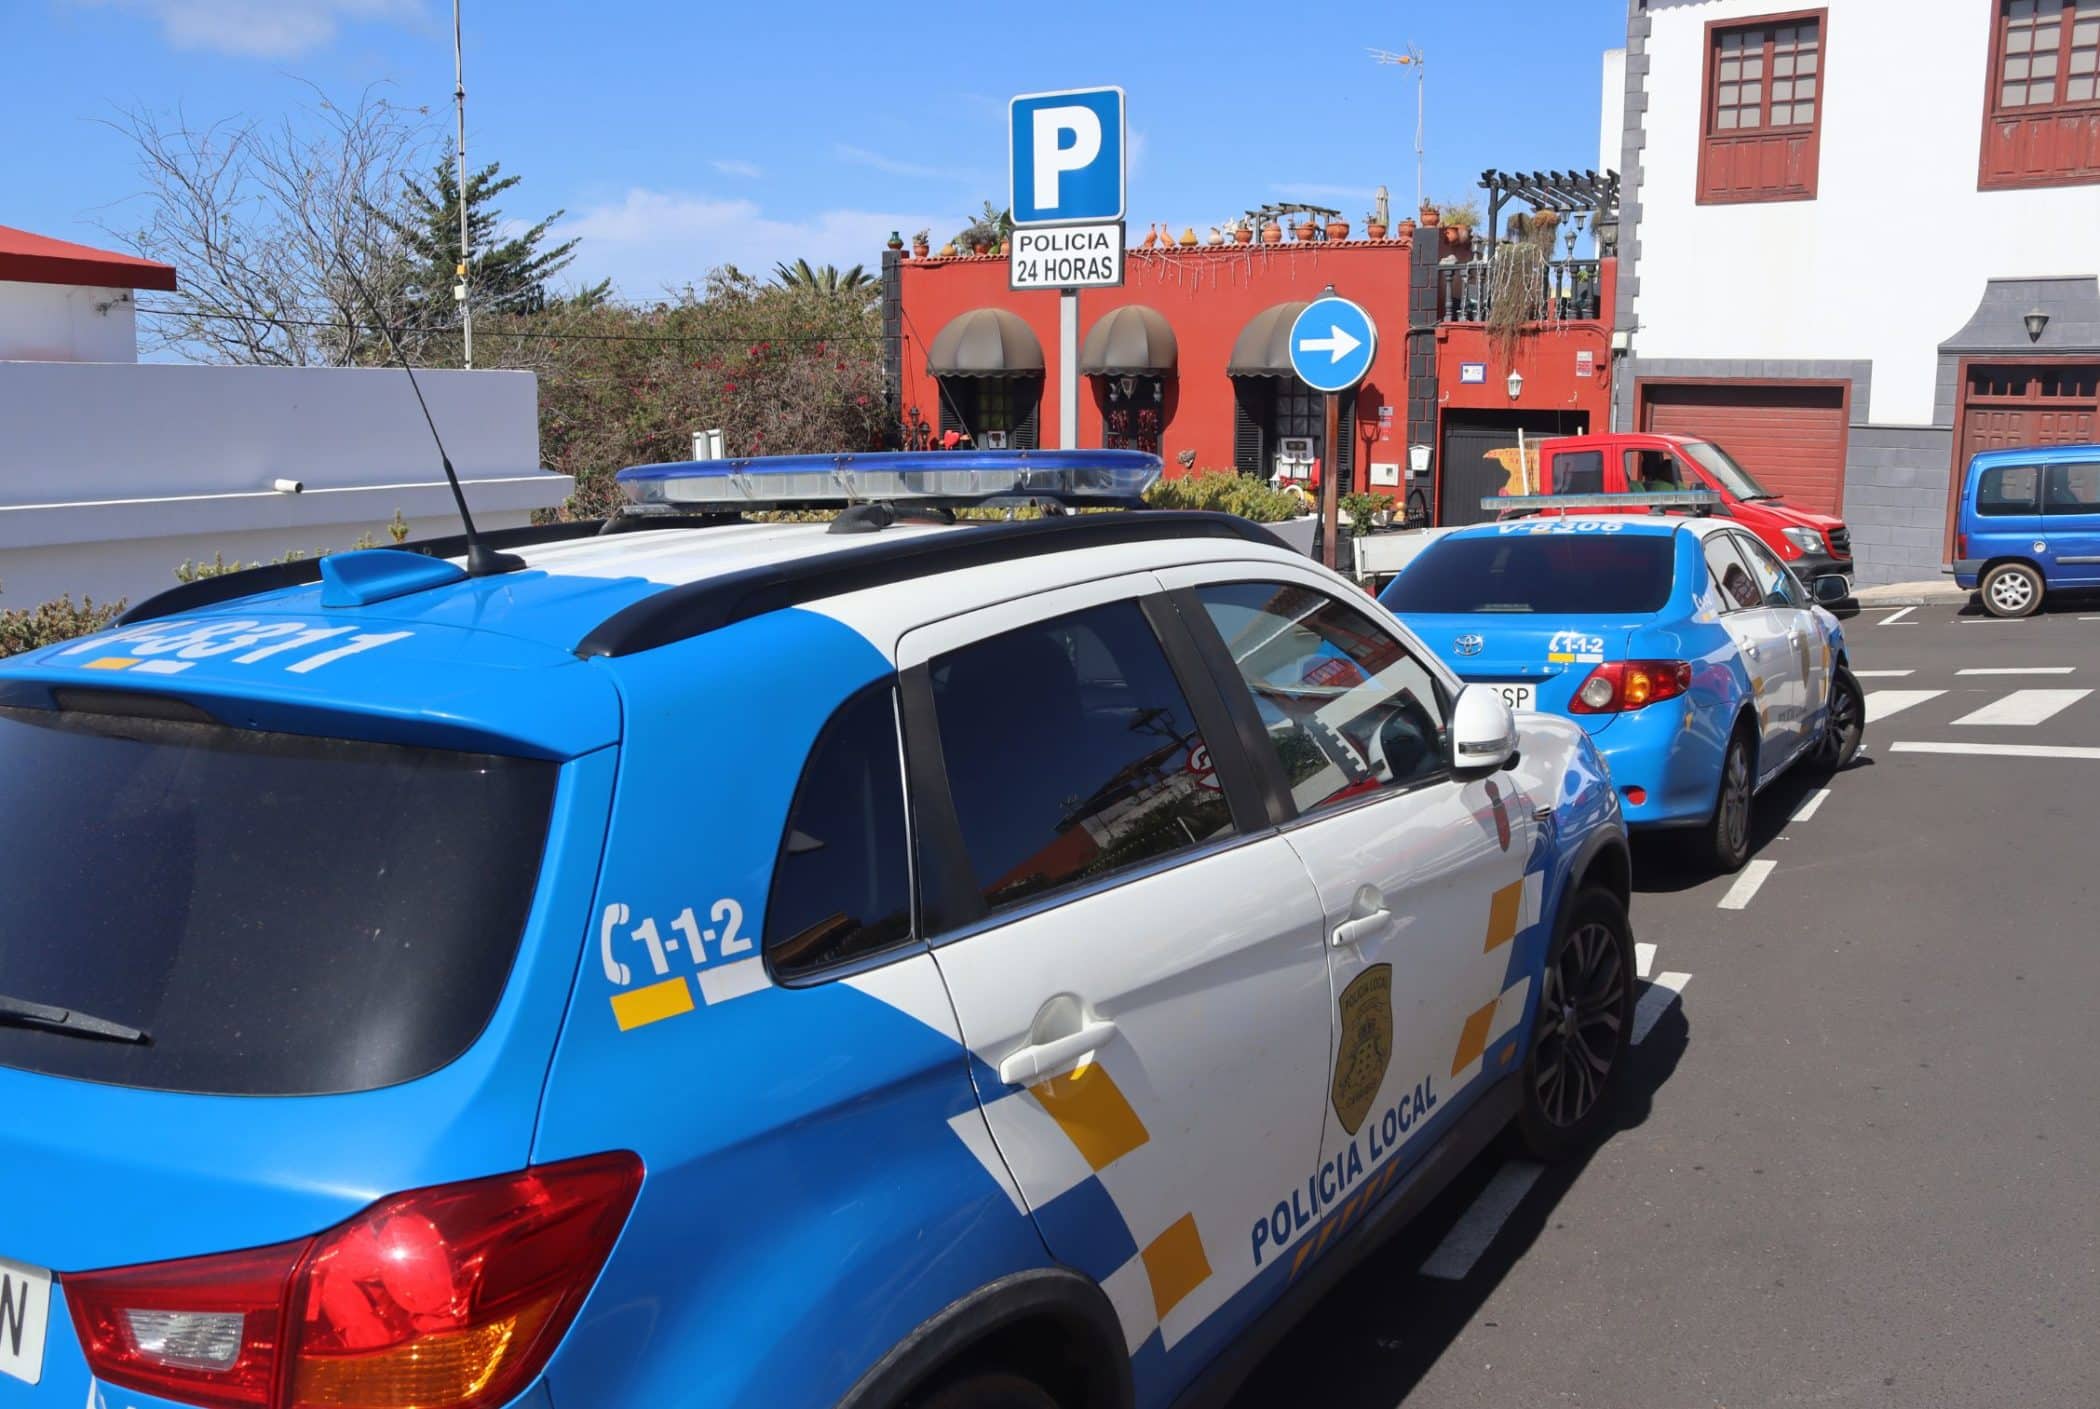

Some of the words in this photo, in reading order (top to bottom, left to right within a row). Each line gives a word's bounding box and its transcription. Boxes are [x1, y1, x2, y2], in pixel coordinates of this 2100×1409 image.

[1033, 105, 1101, 210] P
[1019, 232, 1109, 252] POLICIA
[1017, 260, 1038, 282] 24
[1044, 257, 1112, 281] HORAS
[1562, 638, 1603, 652] 1-1-2
[631, 898, 752, 975] 1-1-2
[1252, 1141, 1363, 1267] POLICIA
[1368, 1074, 1437, 1162] LOCAL
